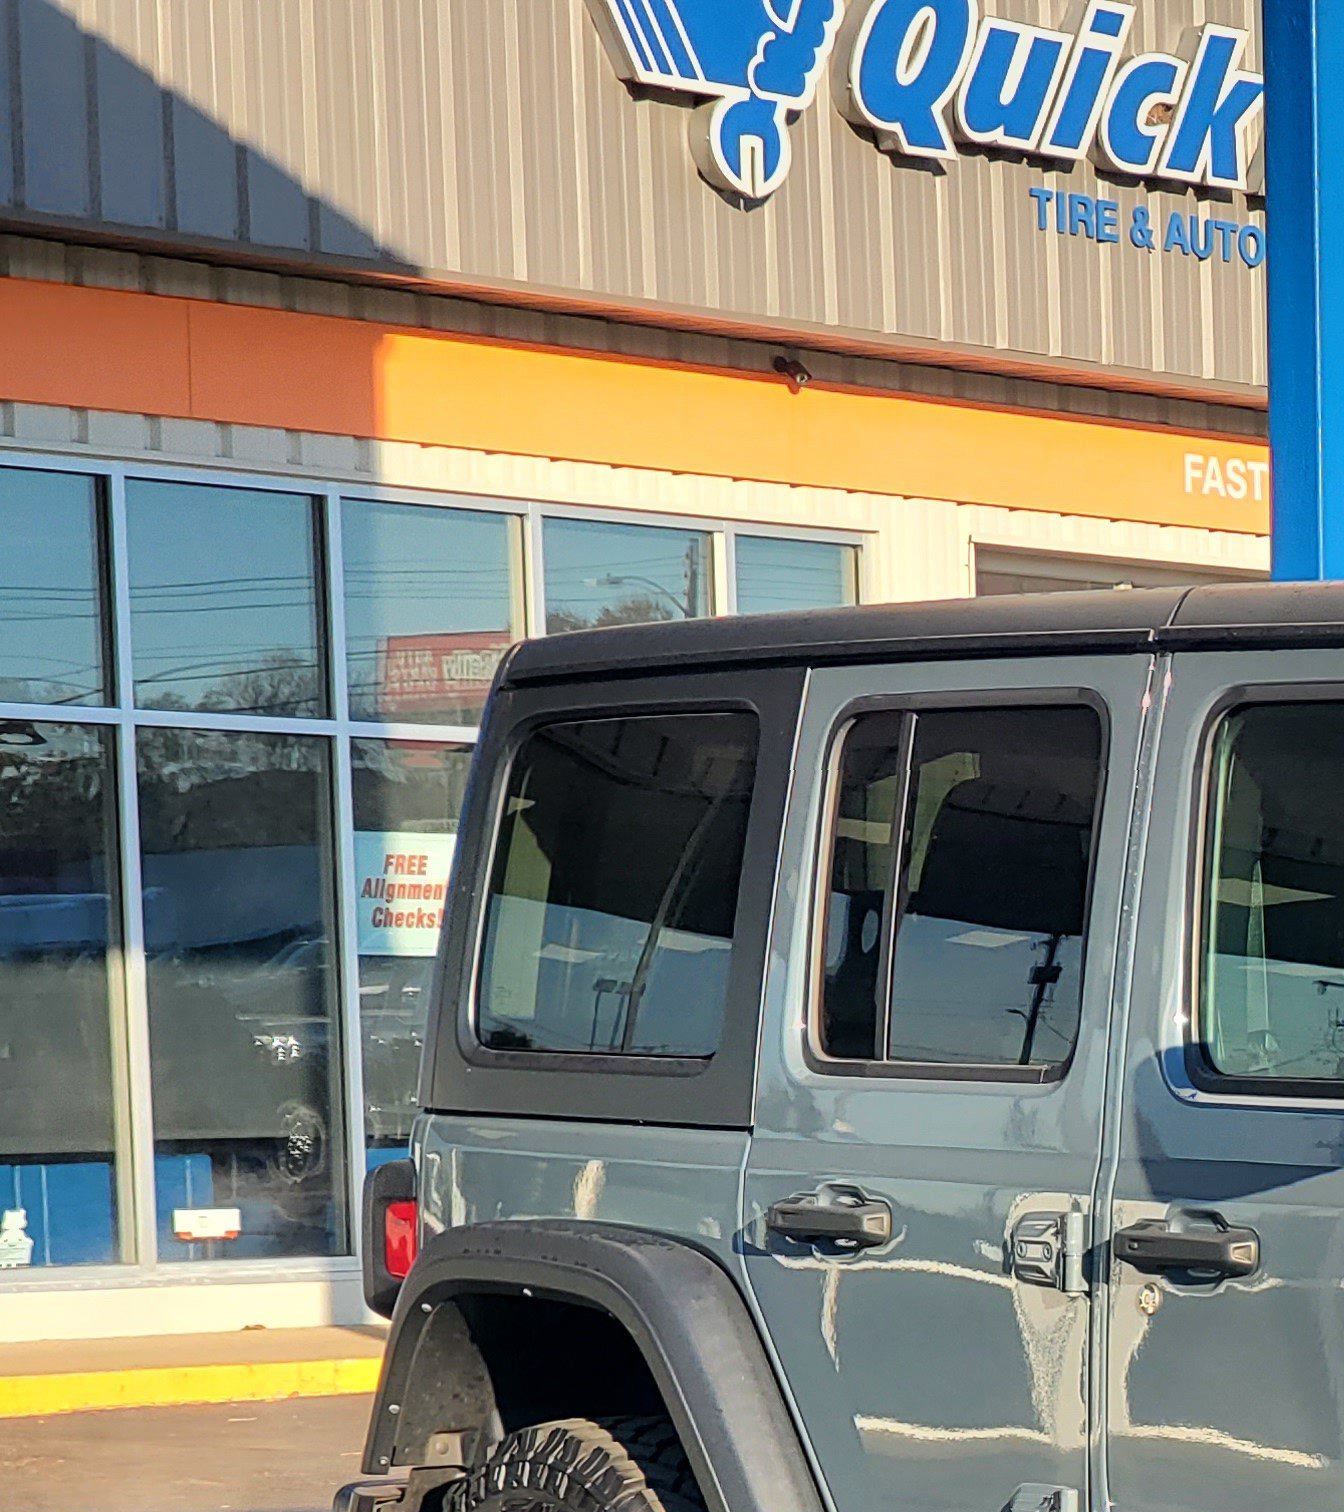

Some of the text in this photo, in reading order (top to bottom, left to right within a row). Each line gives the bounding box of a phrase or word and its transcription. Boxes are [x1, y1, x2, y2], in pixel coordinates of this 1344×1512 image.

[849, 0, 1264, 190] Quick
[1029, 187, 1266, 268] TIRE & AUTO
[1183, 452, 1269, 501] FAST
[383, 853, 429, 876] FREE
